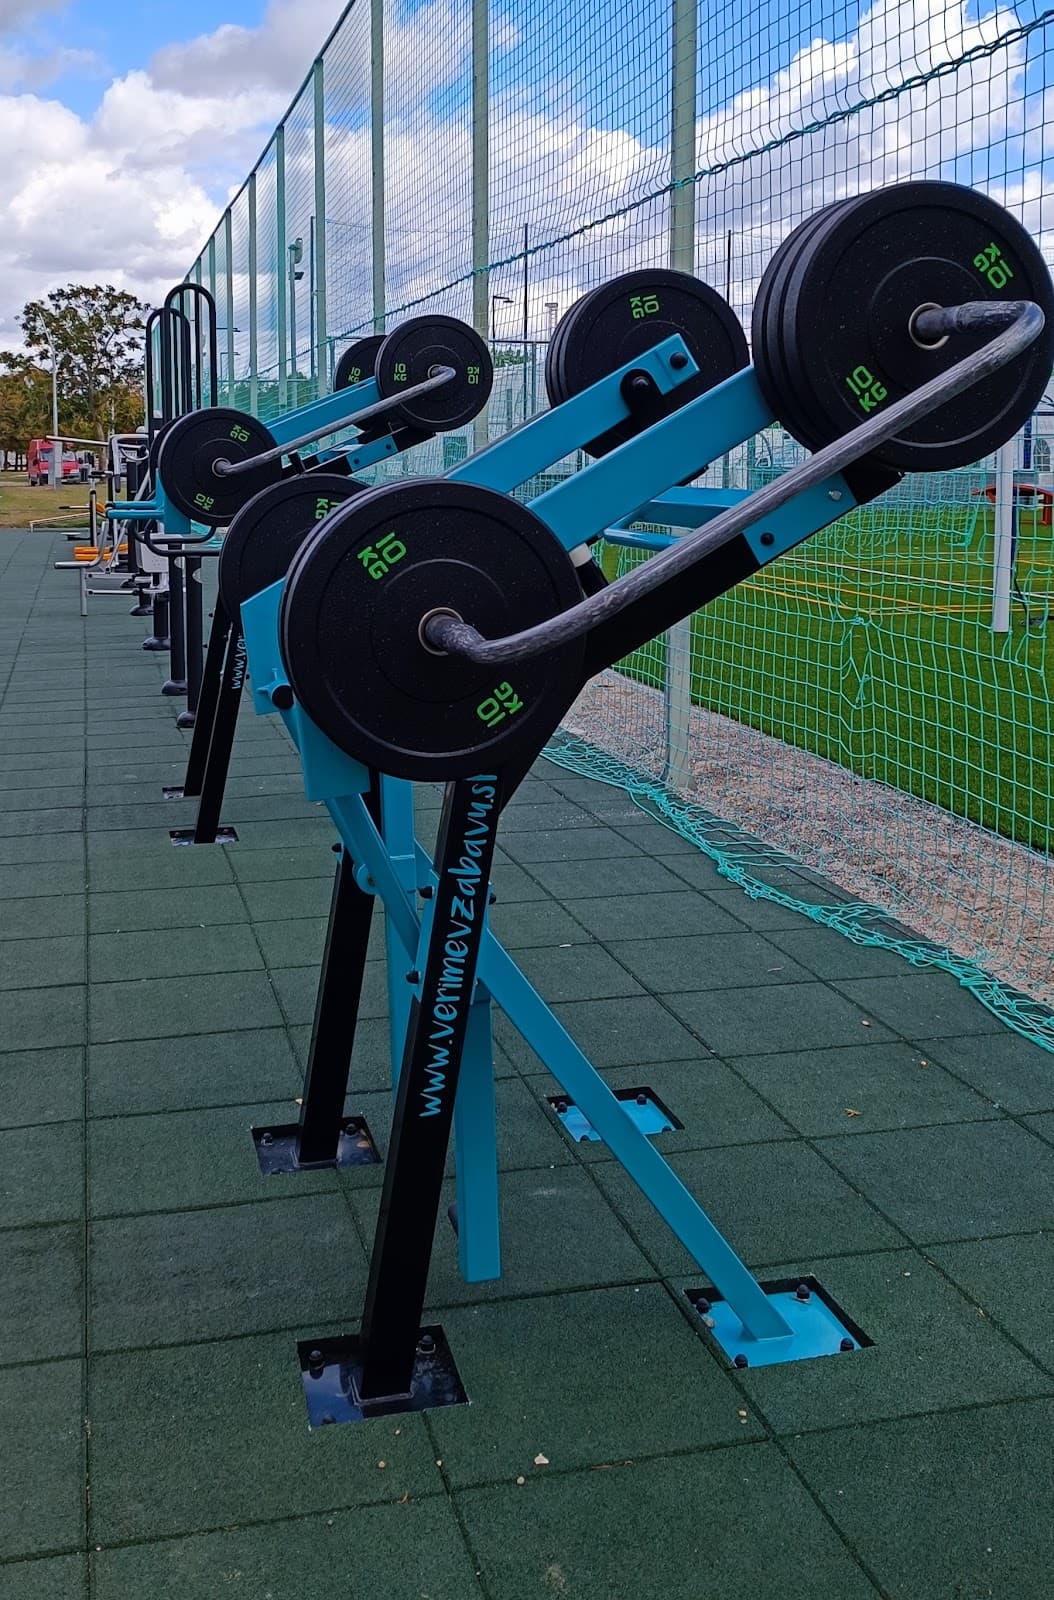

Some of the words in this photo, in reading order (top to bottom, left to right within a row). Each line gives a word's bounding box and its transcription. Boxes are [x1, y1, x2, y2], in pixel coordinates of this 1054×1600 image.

[972, 242, 1002, 273] KG
[986, 259, 1014, 289] 10
[629, 296, 645, 319] KG
[642, 294, 660, 314] 10
[393, 373, 408, 382] KG
[394, 363, 407, 374] 10
[466, 366, 480, 375] KG
[467, 374, 479, 385] 10
[846, 365, 875, 395] 10
[859, 381, 889, 413] KG
[315, 498, 329, 519] KG
[375, 532, 408, 564] 10
[357, 546, 390, 581] KG
[476, 697, 506, 728] 10
[494, 681, 524, 714] KG
